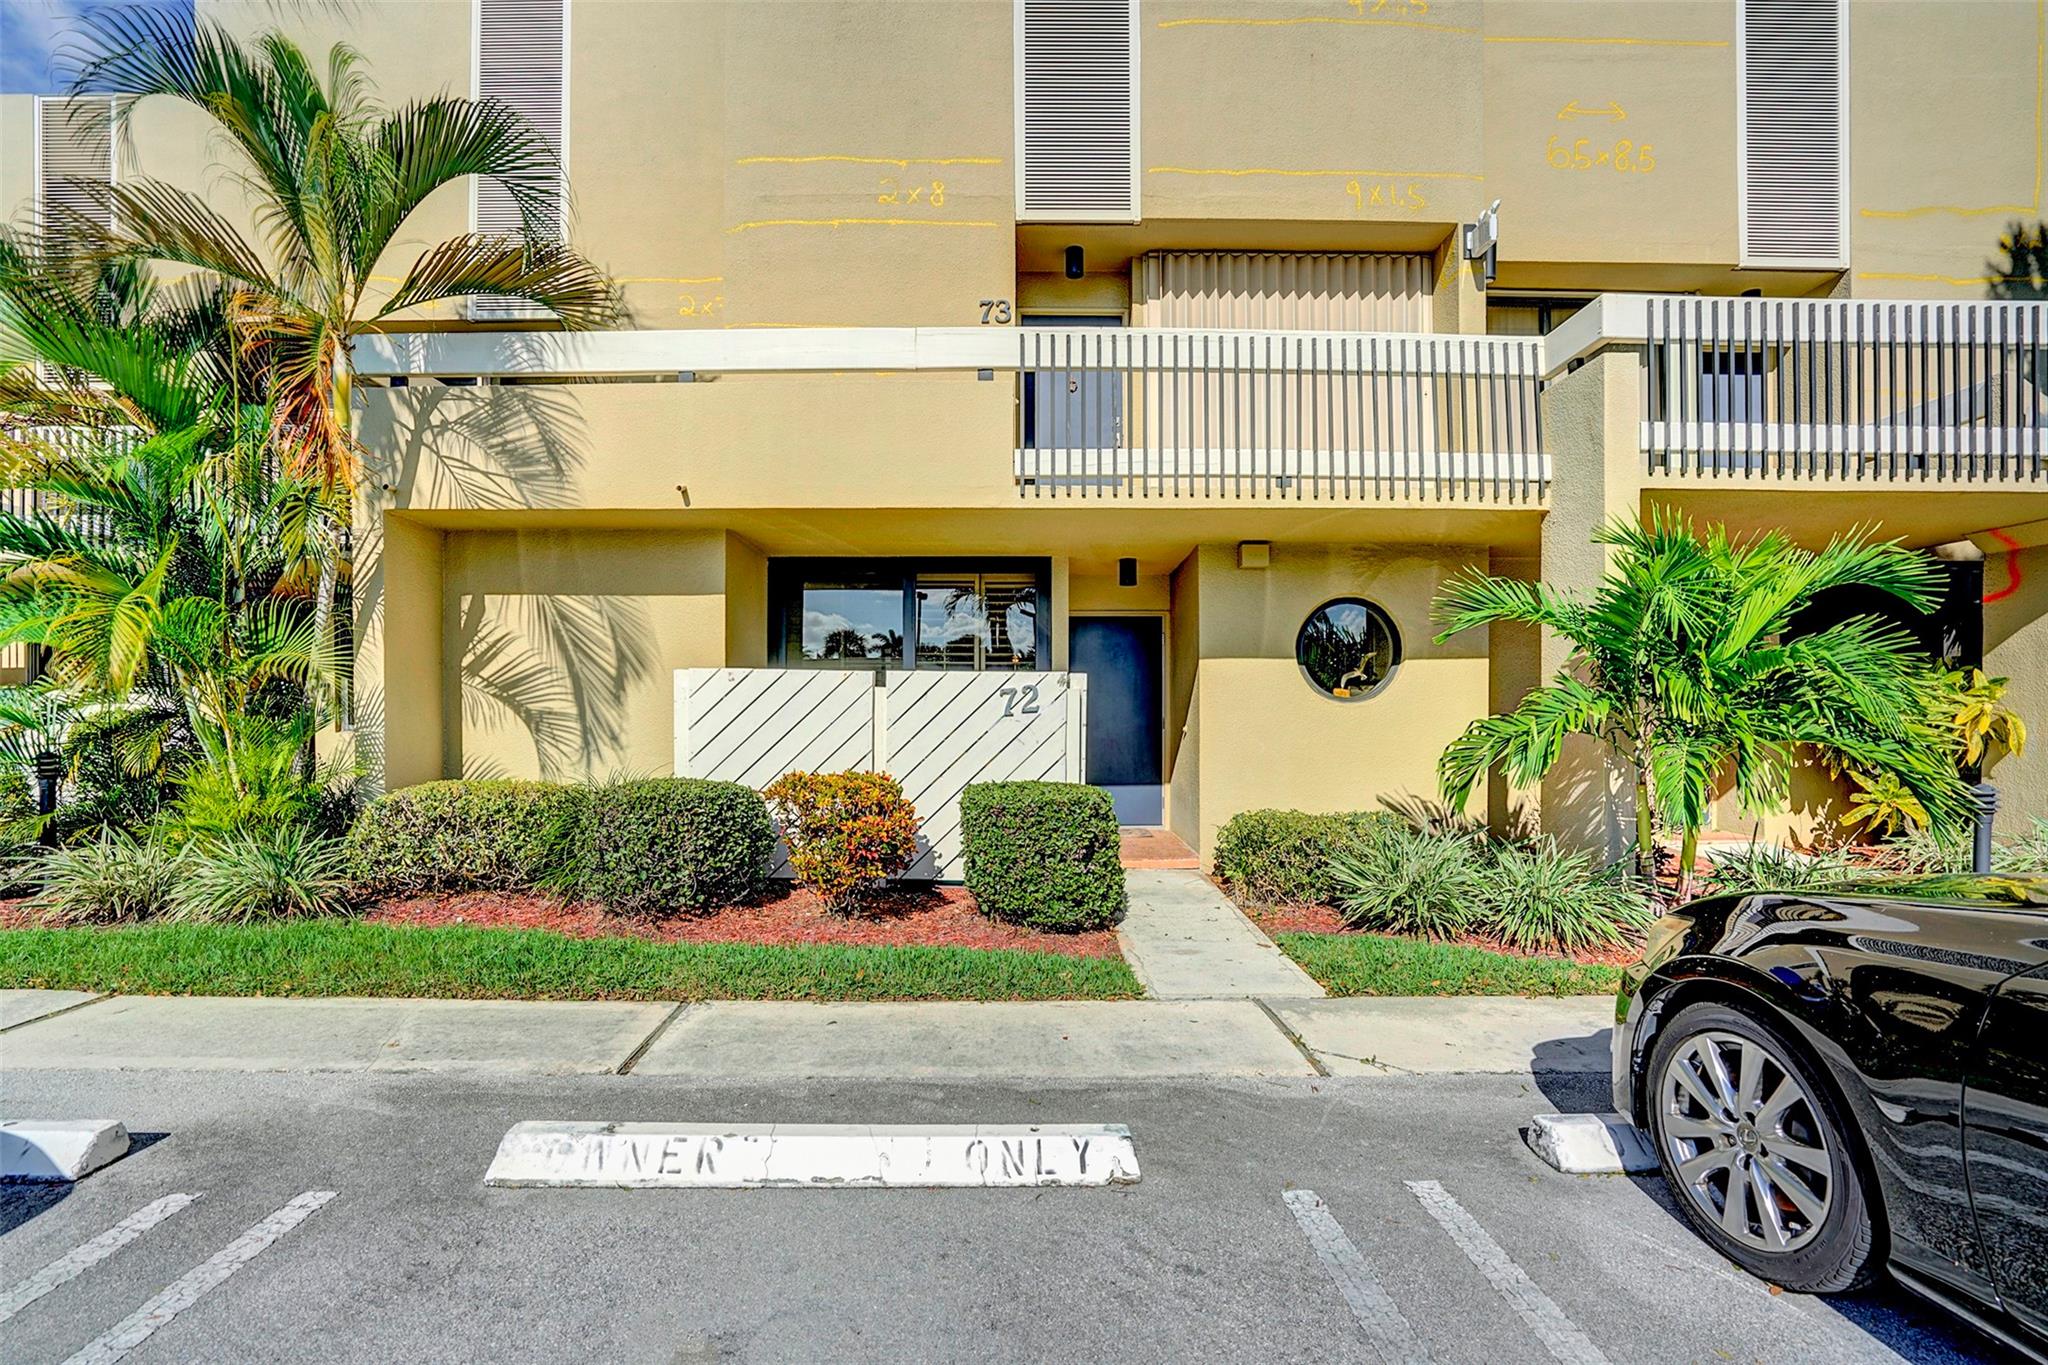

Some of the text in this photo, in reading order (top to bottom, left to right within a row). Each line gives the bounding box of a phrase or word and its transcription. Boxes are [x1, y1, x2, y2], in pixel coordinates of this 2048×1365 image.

[979, 299, 1012, 324] 73
[1000, 684, 1040, 717] 72
[965, 1137, 1090, 1178] ONLY
